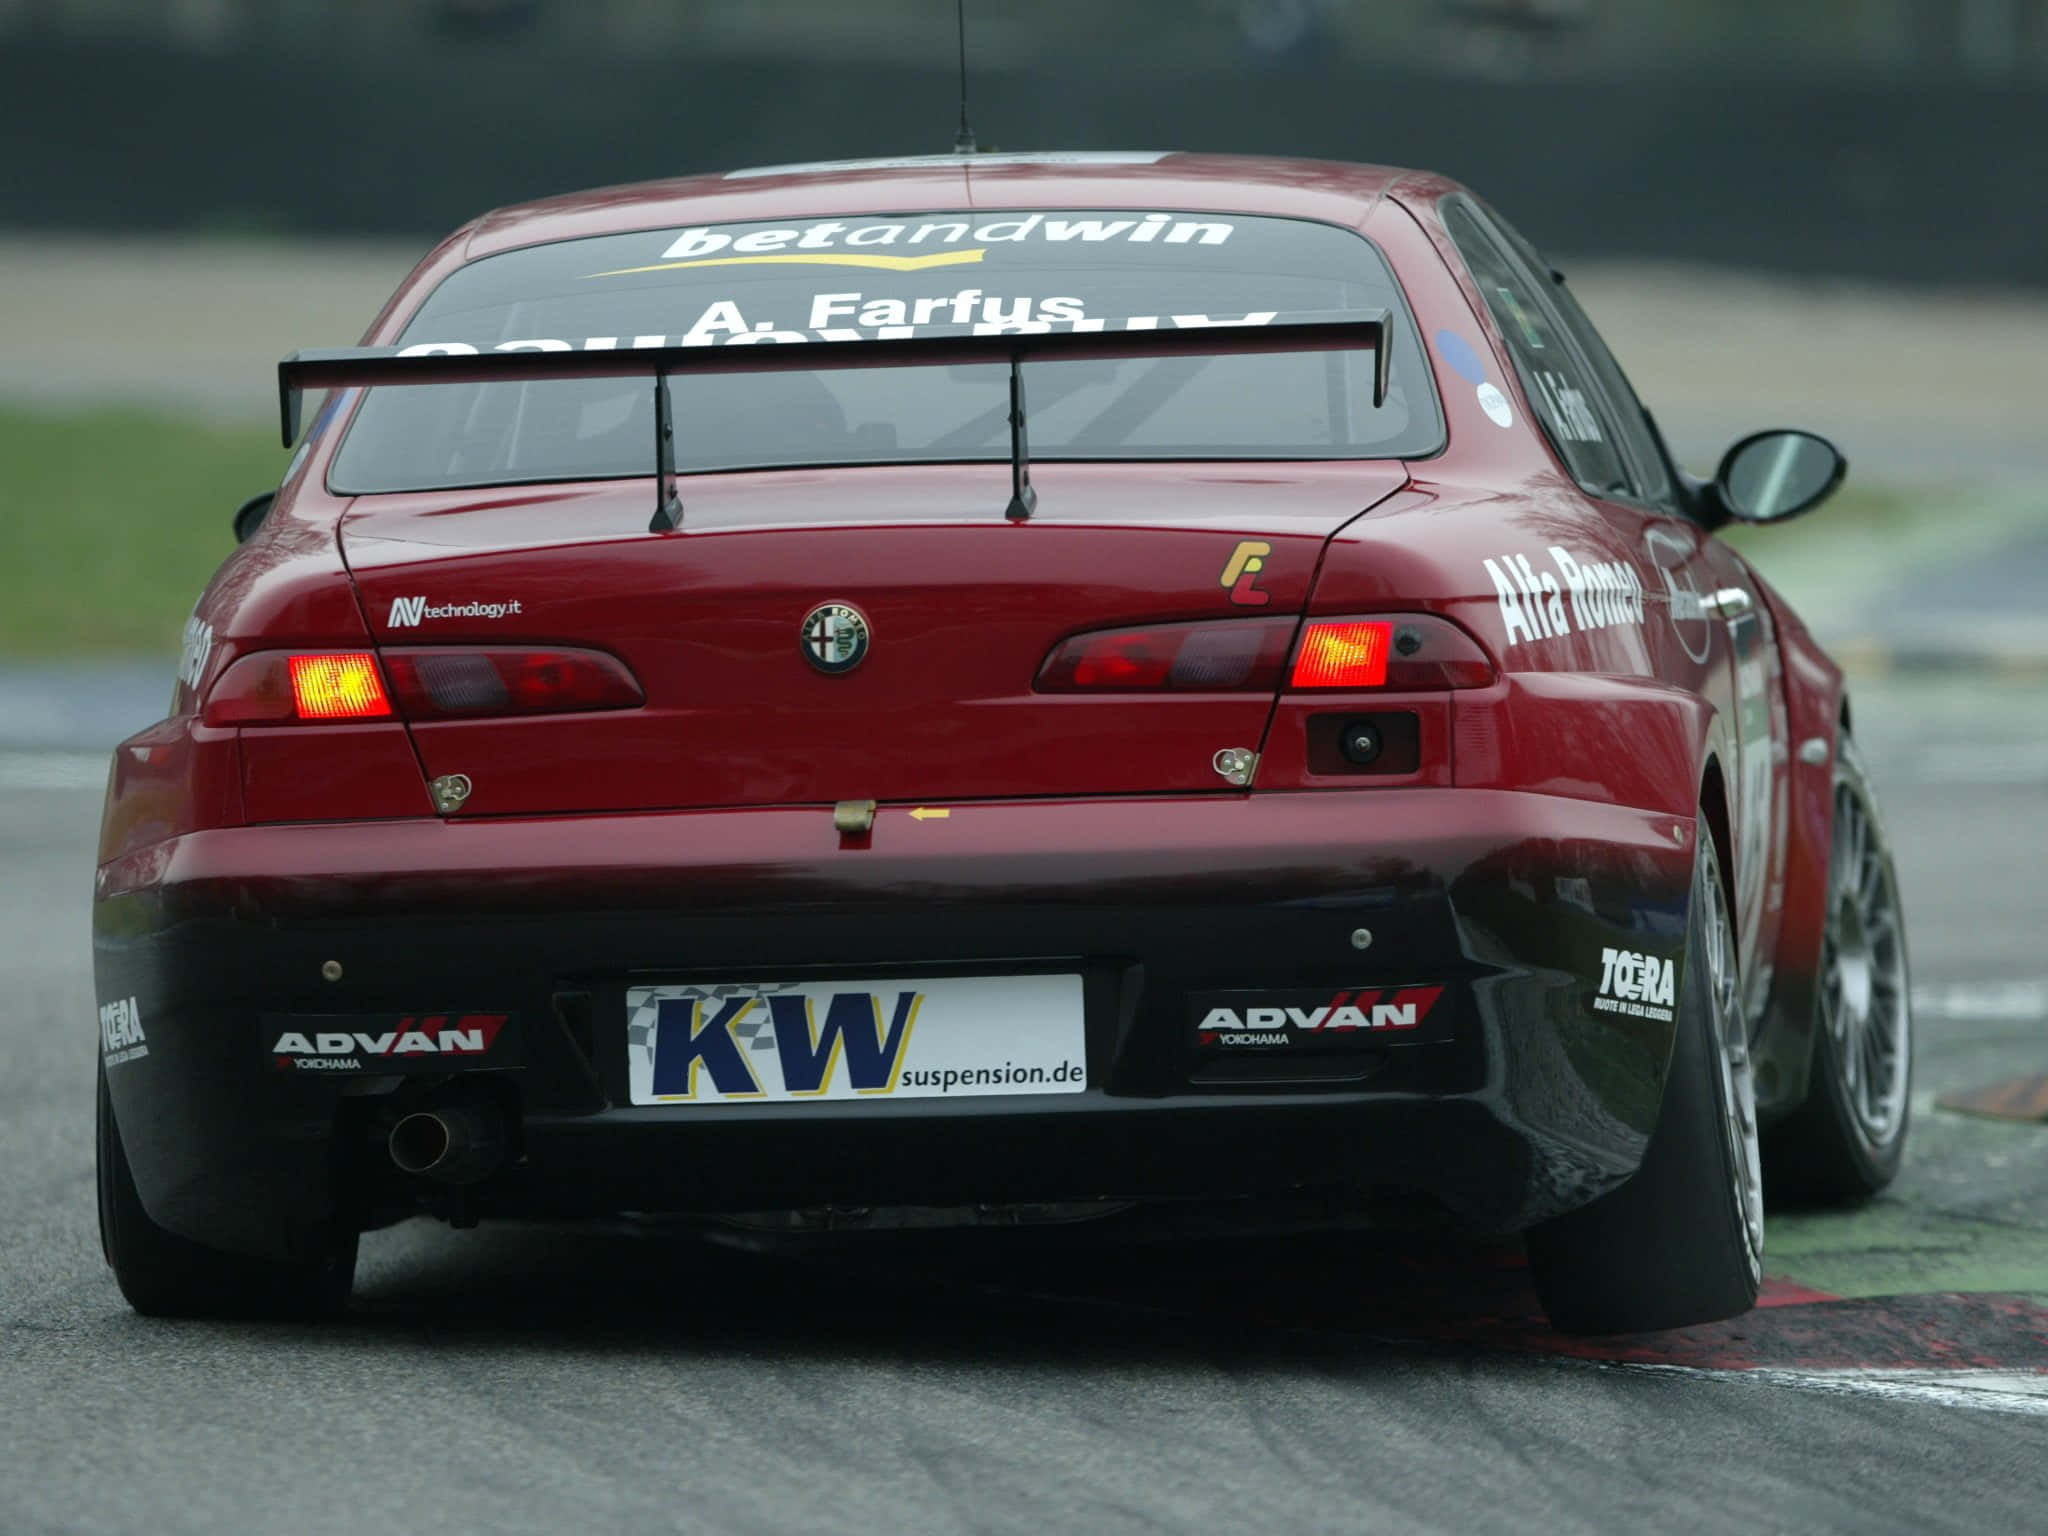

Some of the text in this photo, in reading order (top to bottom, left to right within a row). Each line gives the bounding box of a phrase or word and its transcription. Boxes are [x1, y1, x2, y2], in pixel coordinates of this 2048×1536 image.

[661, 214, 1235, 260] betandwin
[808, 289, 1086, 329] Farfus
[1483, 553, 1571, 646] Alfa
[1548, 546, 1645, 631] Romeo
[1197, 1003, 1418, 1031] ADVAN
[271, 1028, 486, 1055] ADVAN
[652, 991, 926, 1101] KW
[1218, 1033, 1290, 1046] YOKOHAMA
[293, 1057, 362, 1070] YOKOHAMA
[901, 1060, 1085, 1093] suspension.de
